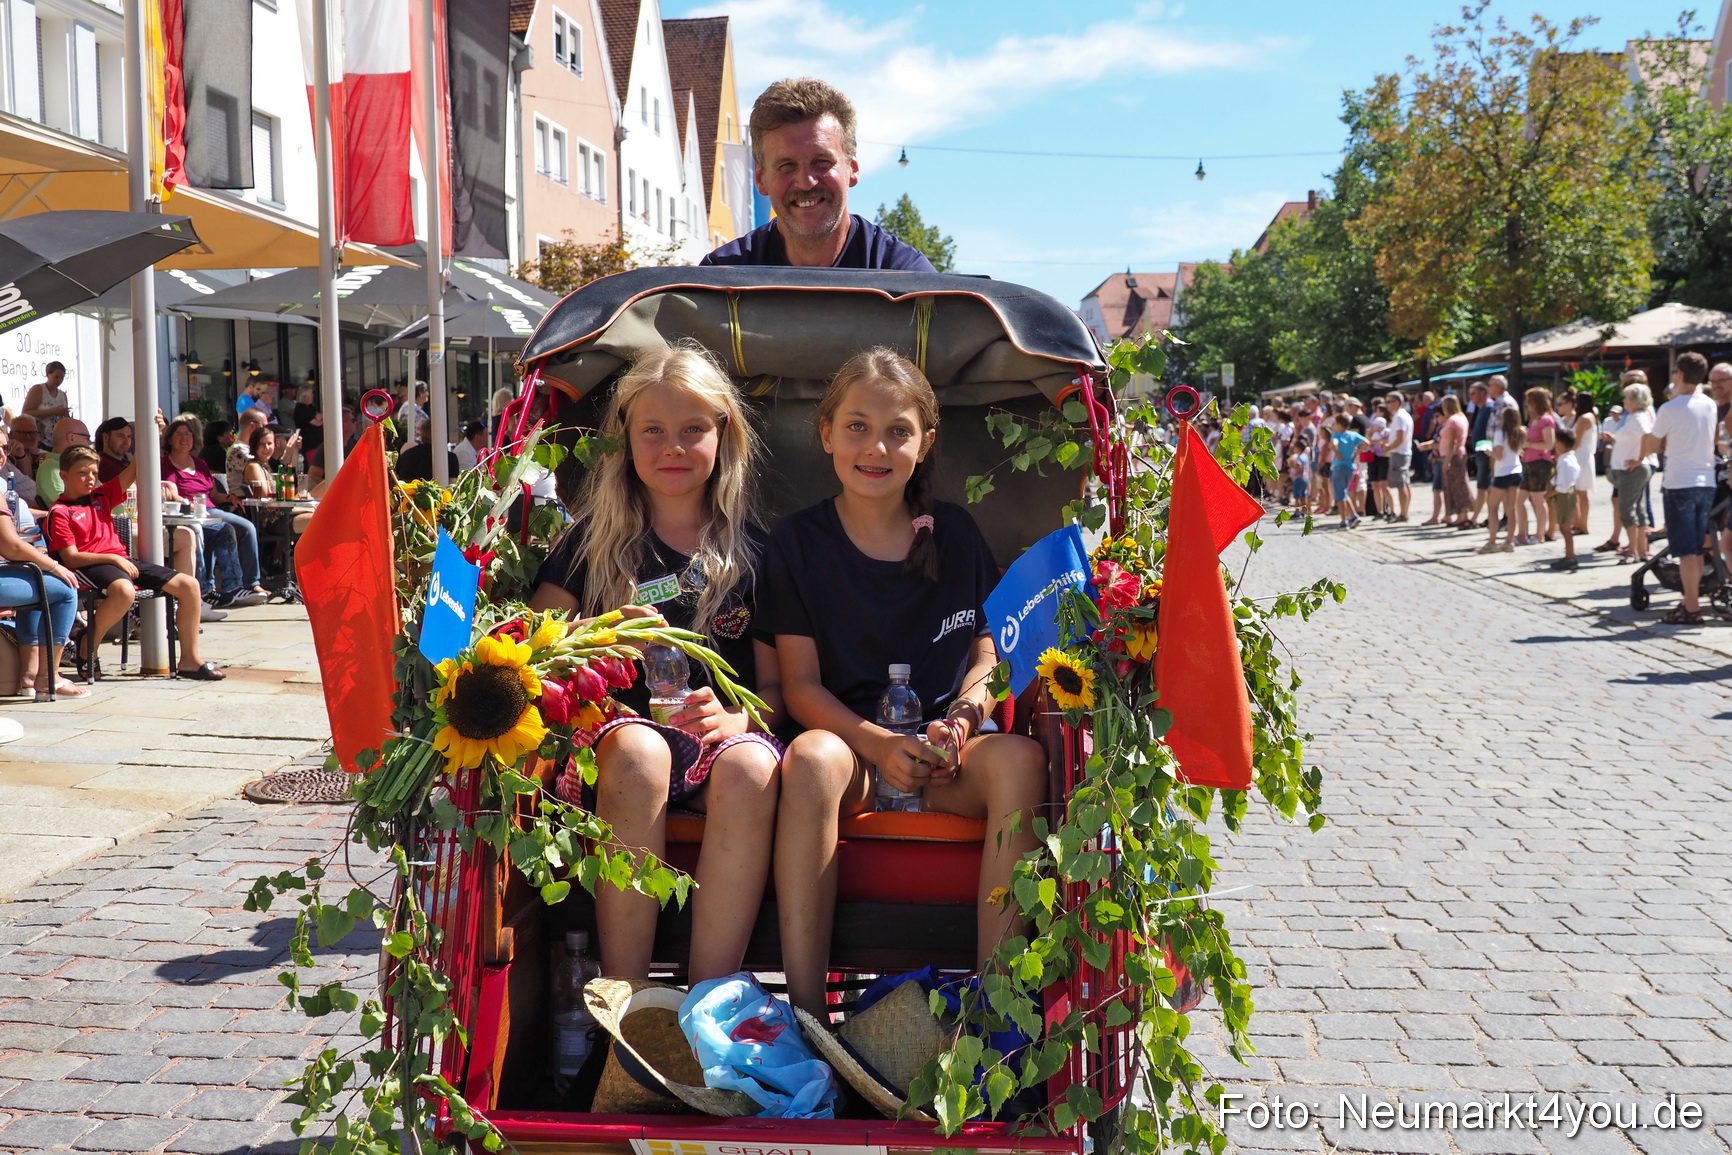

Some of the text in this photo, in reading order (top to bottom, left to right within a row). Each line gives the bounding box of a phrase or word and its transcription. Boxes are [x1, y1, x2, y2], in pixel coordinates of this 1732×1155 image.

[16, 332, 60, 357] 30 Jahre
[1, 358, 28, 381] Bang
[31, 361, 37, 377] &
[11, 384, 20, 399] in
[720, 617, 741, 629] Maus
[932, 609, 976, 643] JURA
